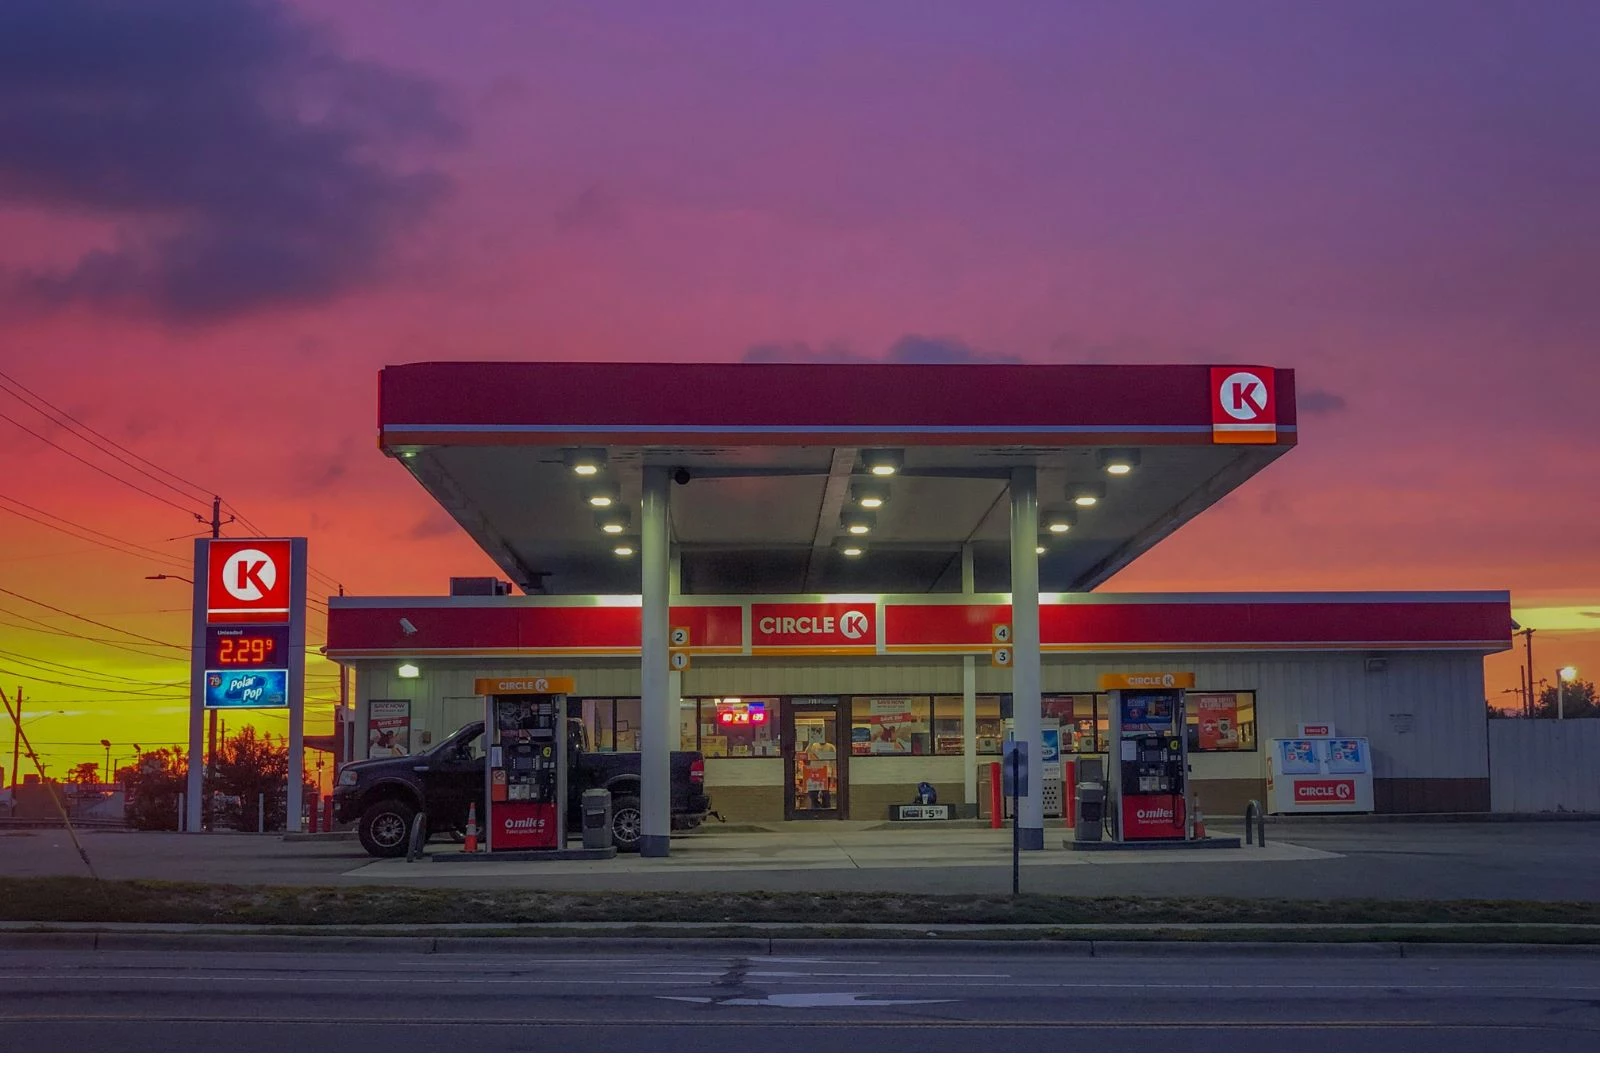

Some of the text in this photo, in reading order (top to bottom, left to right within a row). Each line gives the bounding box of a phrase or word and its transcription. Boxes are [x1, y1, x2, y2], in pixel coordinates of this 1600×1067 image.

[1229, 380, 1263, 417] K
[235, 559, 272, 598] K
[759, 612, 867, 638] CIRCLE K
[675, 632, 683, 641] 2
[998, 629, 1006, 638] 4
[999, 651, 1006, 661] 3
[230, 676, 257, 691] Polar
[498, 678, 549, 691] CIRCLE K
[1128, 674, 1175, 687] CIRCLE K
[243, 687, 263, 701] Pop
[1298, 783, 1350, 799] CIRCLE K
